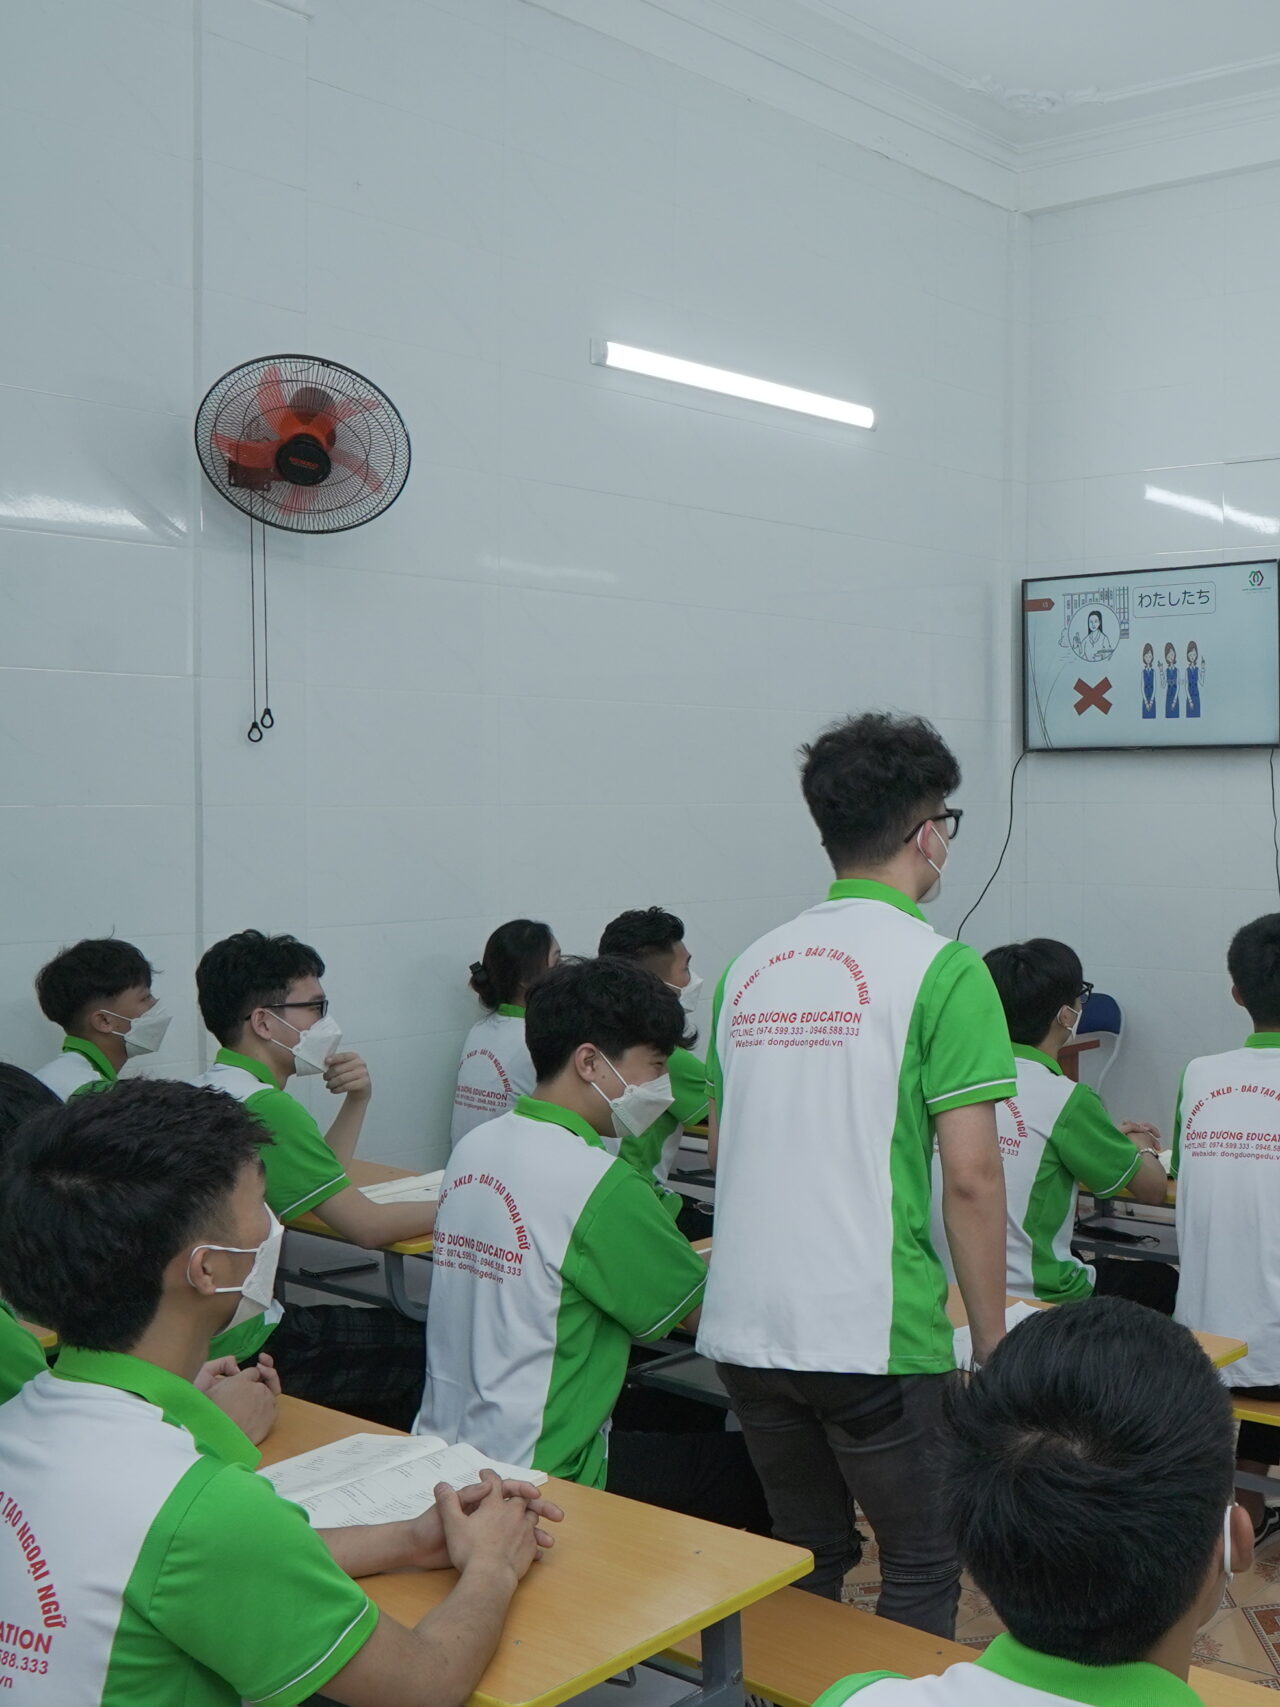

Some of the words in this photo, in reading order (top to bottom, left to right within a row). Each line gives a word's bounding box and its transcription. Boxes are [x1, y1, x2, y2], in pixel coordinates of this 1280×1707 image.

[1137, 588, 1210, 608] わたしたち
[800, 1010, 862, 1024] EDUCATION
[476, 1242, 523, 1265] EDUCATION
[2, 1497, 23, 1527] TẠO
[16, 1521, 50, 1582] NGOẠI
[37, 1583, 67, 1629] NGỮ
